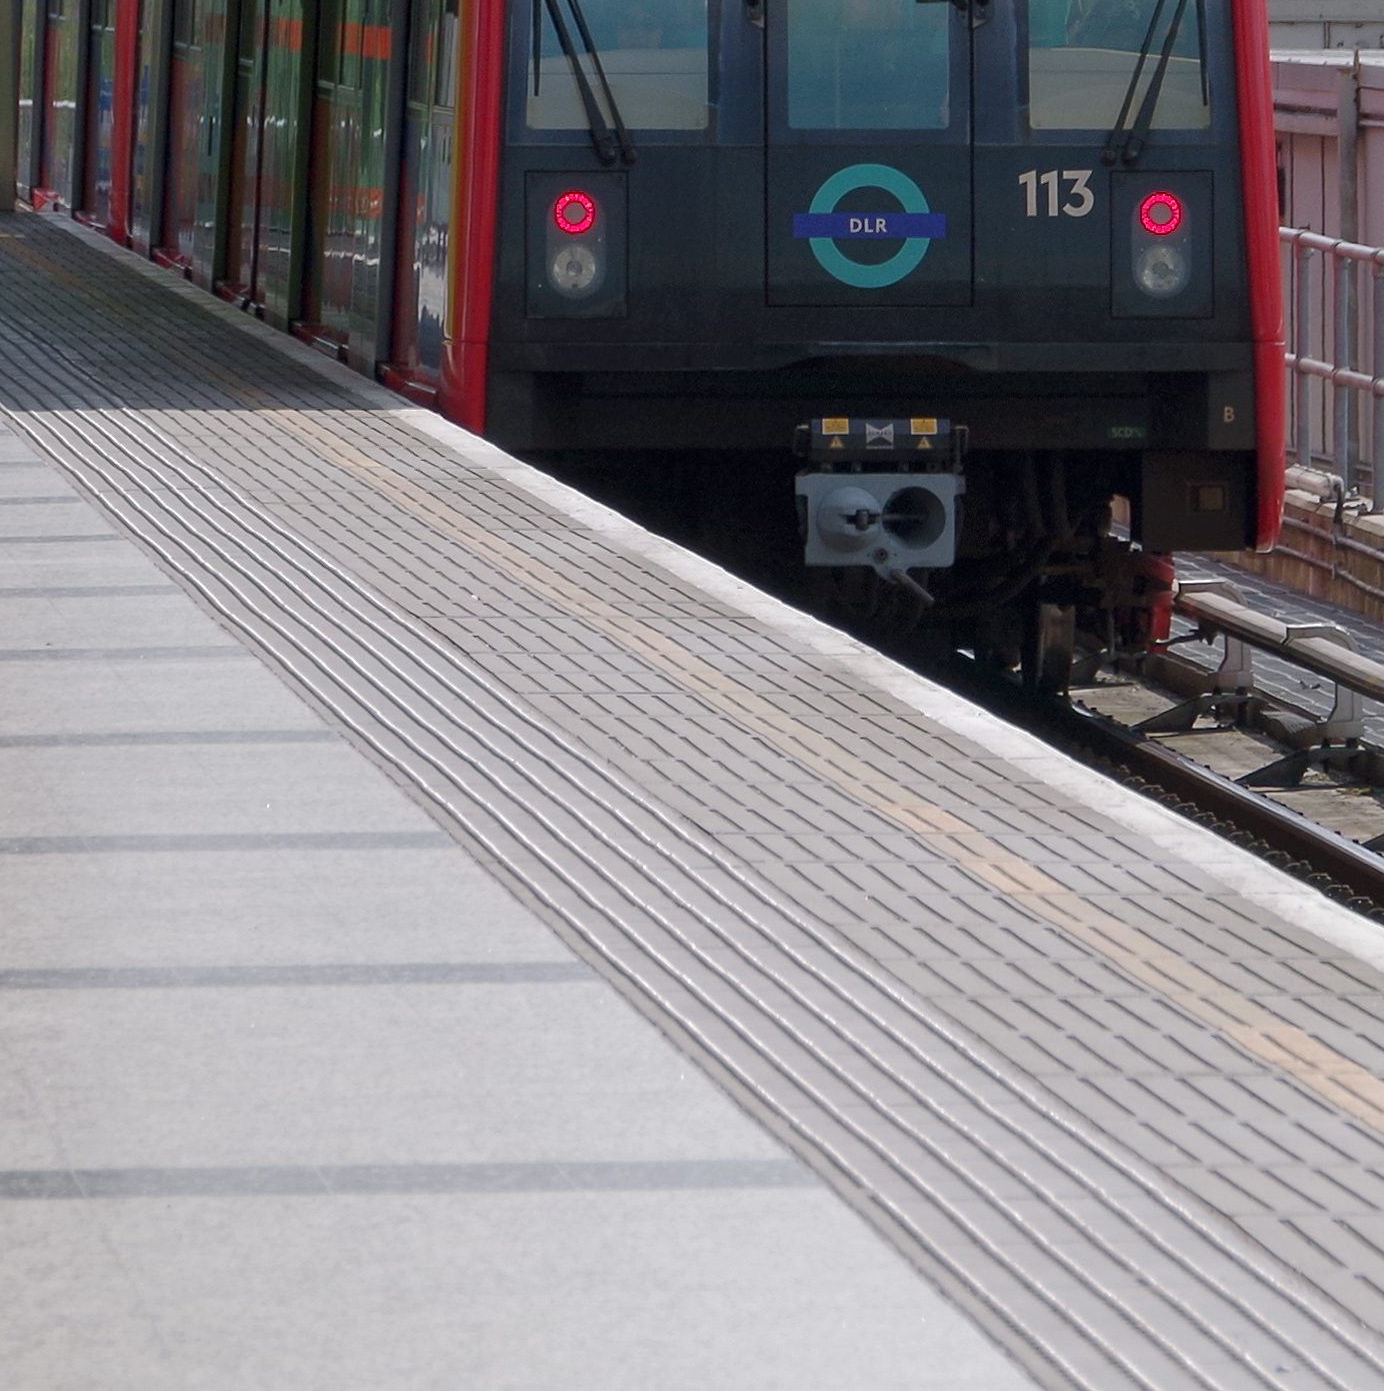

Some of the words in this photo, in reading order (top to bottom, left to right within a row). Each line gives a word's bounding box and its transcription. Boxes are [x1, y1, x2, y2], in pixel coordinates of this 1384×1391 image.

[1018, 169, 1095, 218] 113
[849, 218, 887, 234] DLR
[1223, 406, 1234, 423] B
